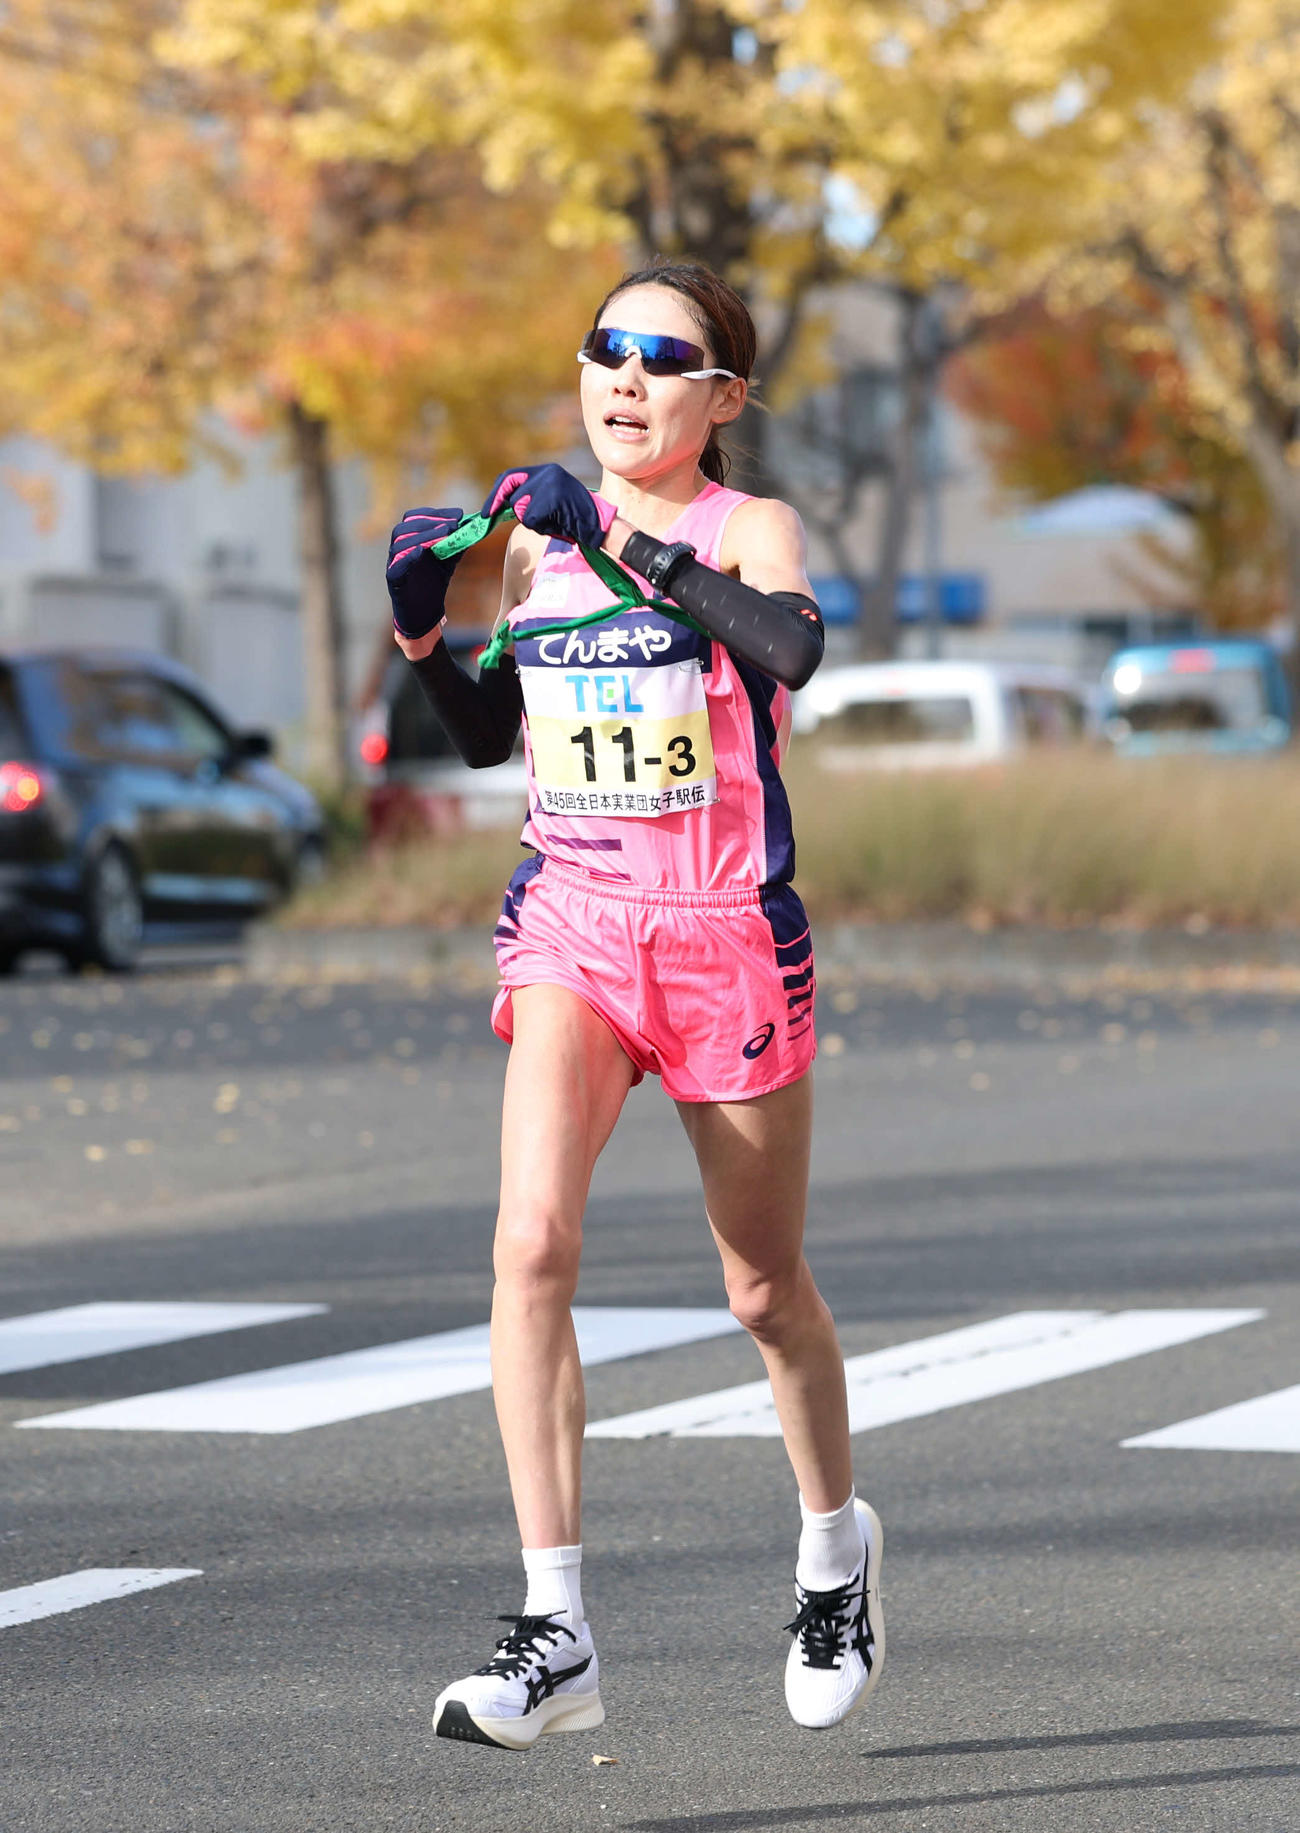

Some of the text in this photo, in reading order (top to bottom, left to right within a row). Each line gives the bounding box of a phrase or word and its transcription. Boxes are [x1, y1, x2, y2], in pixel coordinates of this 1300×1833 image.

[533, 625, 672, 665] てんまや
[565, 674, 644, 713] TEL
[571, 726, 697, 783] 11-3
